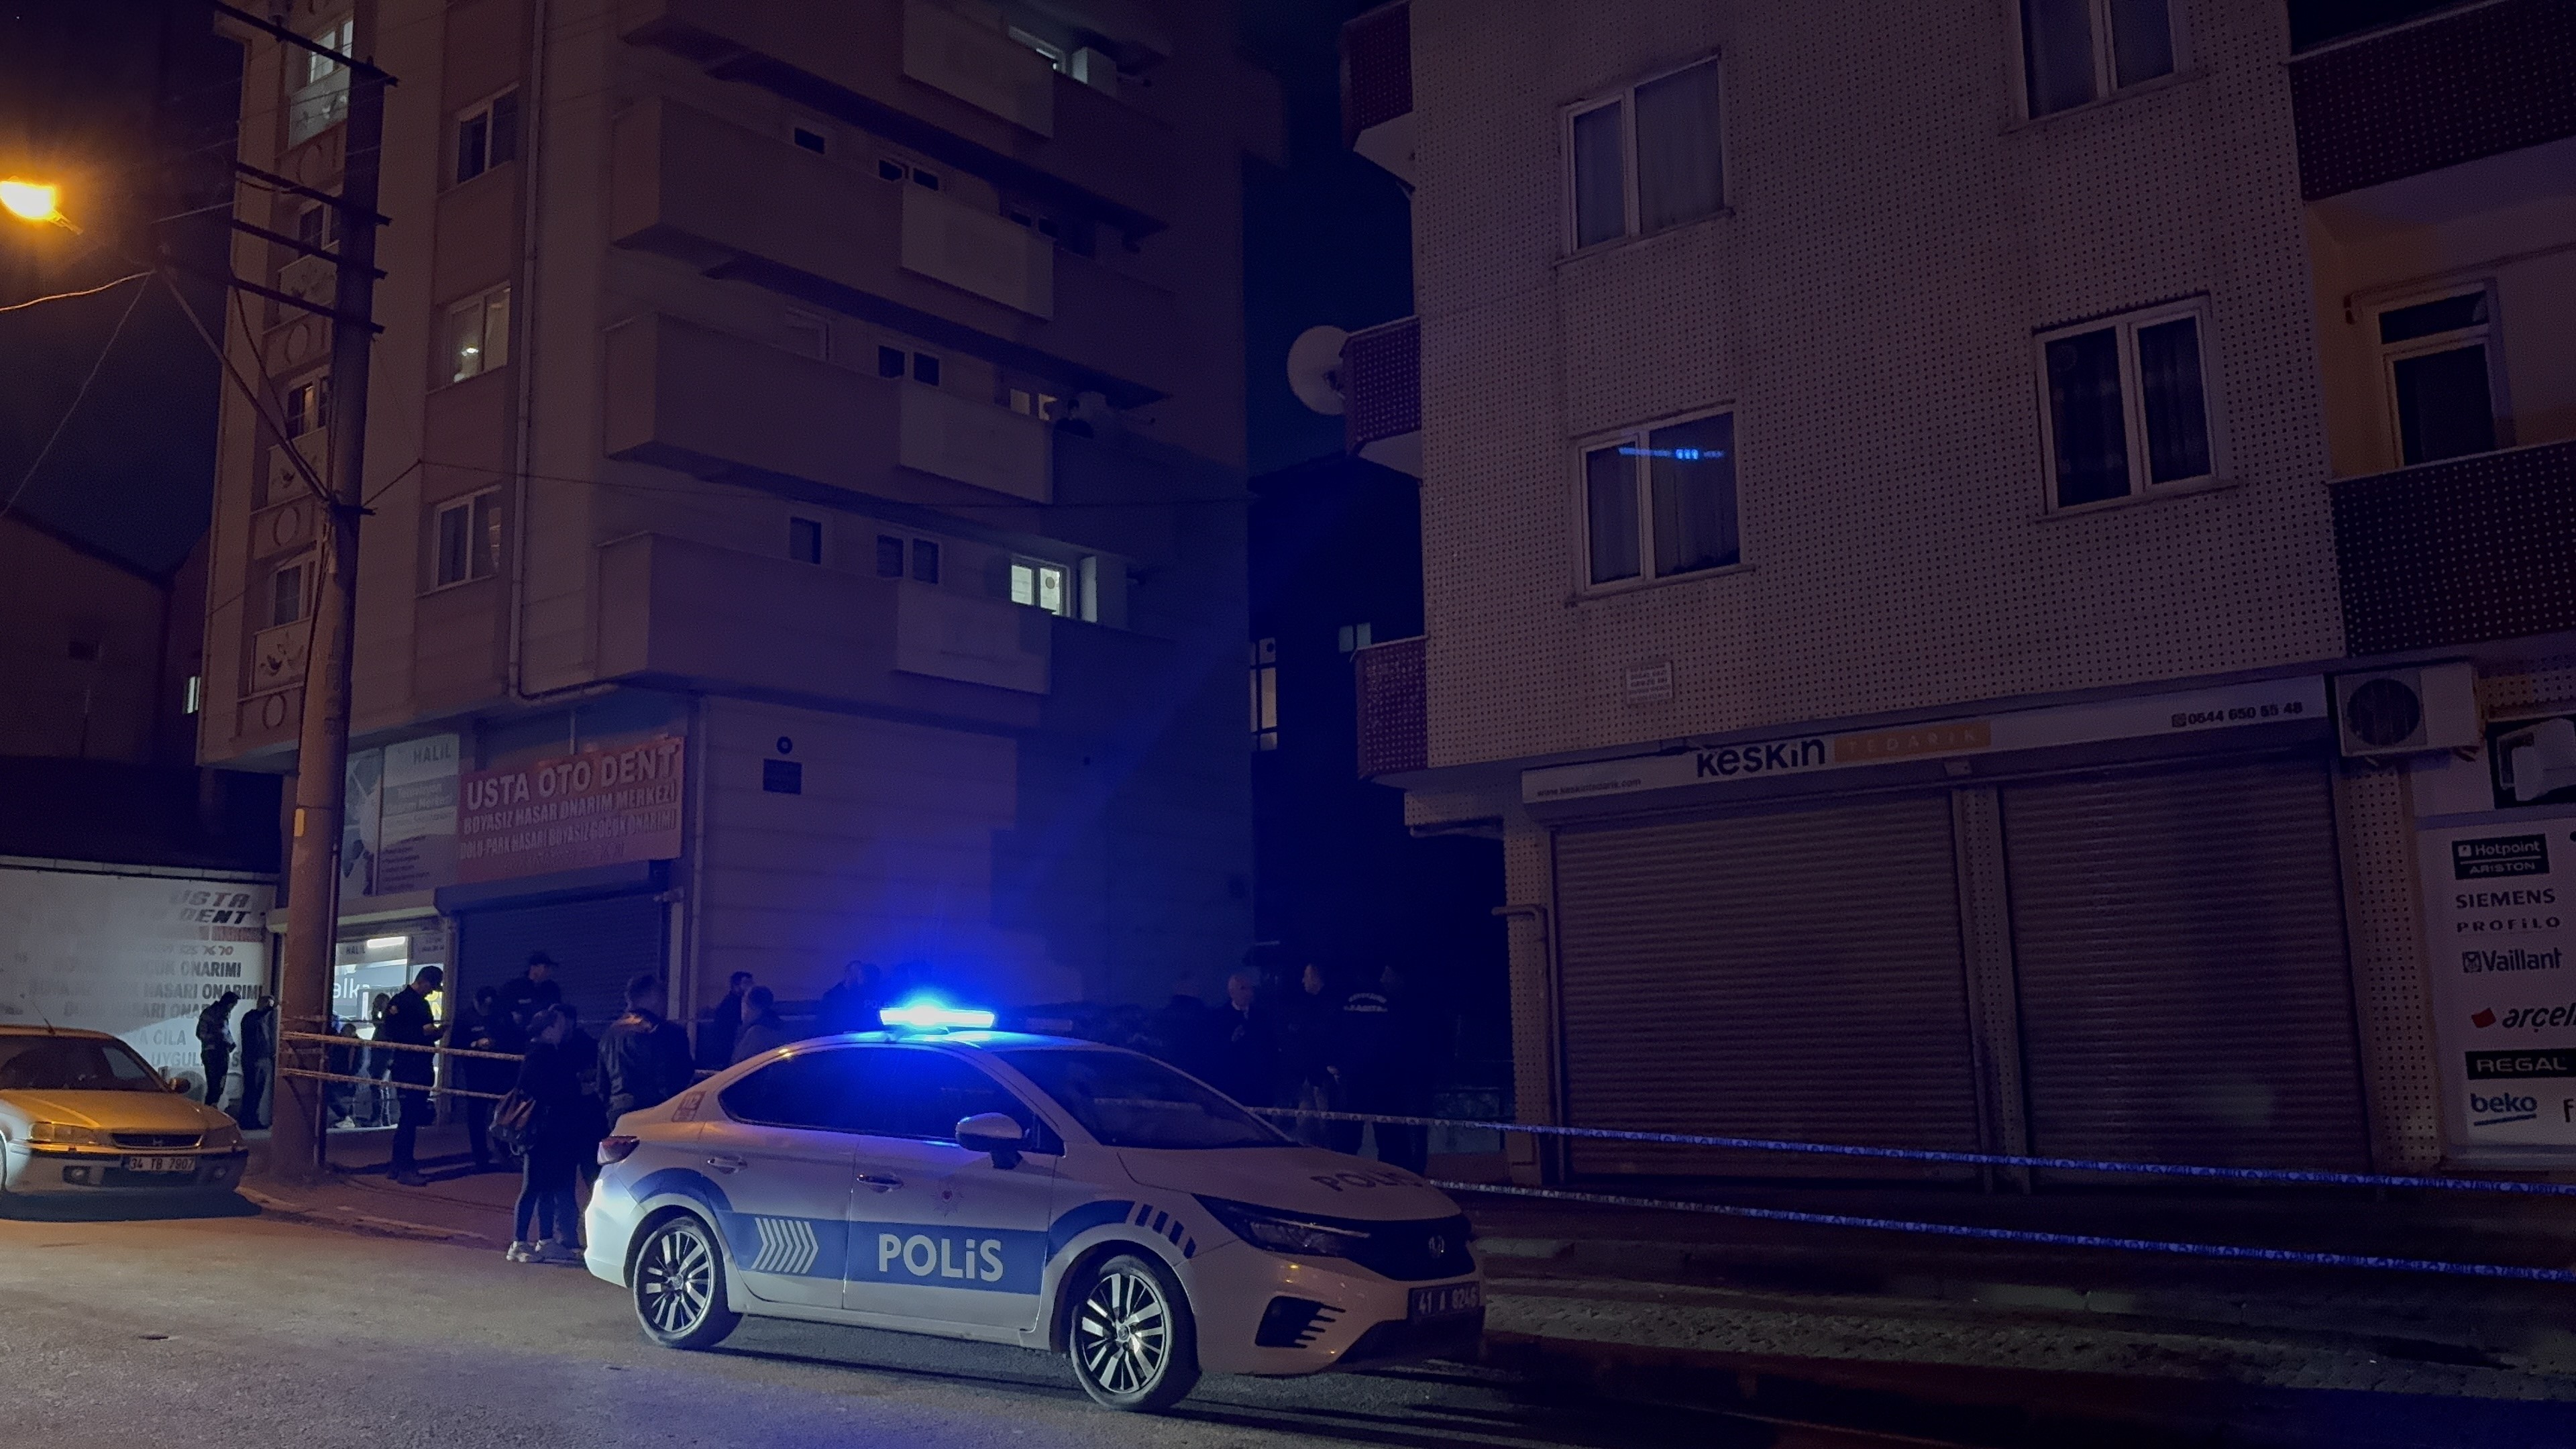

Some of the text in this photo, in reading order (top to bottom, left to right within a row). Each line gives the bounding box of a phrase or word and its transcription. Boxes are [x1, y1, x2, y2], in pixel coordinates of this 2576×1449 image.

[2188, 710, 2224, 724] 0544
[2229, 706, 2256, 720] 650
[2284, 701, 2303, 714] 48
[467, 773, 531, 810] USTA
[539, 761, 592, 798] OTO
[600, 744, 678, 788] DENT
[515, 802, 558, 826] HASAR
[559, 793, 612, 820] ONARIM
[2475, 841, 2540, 856] Hotpoint
[2469, 862, 2536, 875] ARISTON
[2456, 888, 2557, 909] SIEMENS
[2483, 947, 2563, 972] Vaillant
[2502, 1002, 2576, 1033] arçel
[2476, 1057, 2568, 1073] REGAL
[2470, 1092, 2538, 1114] beko
[131, 1157, 195, 1170] 34 TB 7907
[1419, 1291, 1433, 1315] 41
